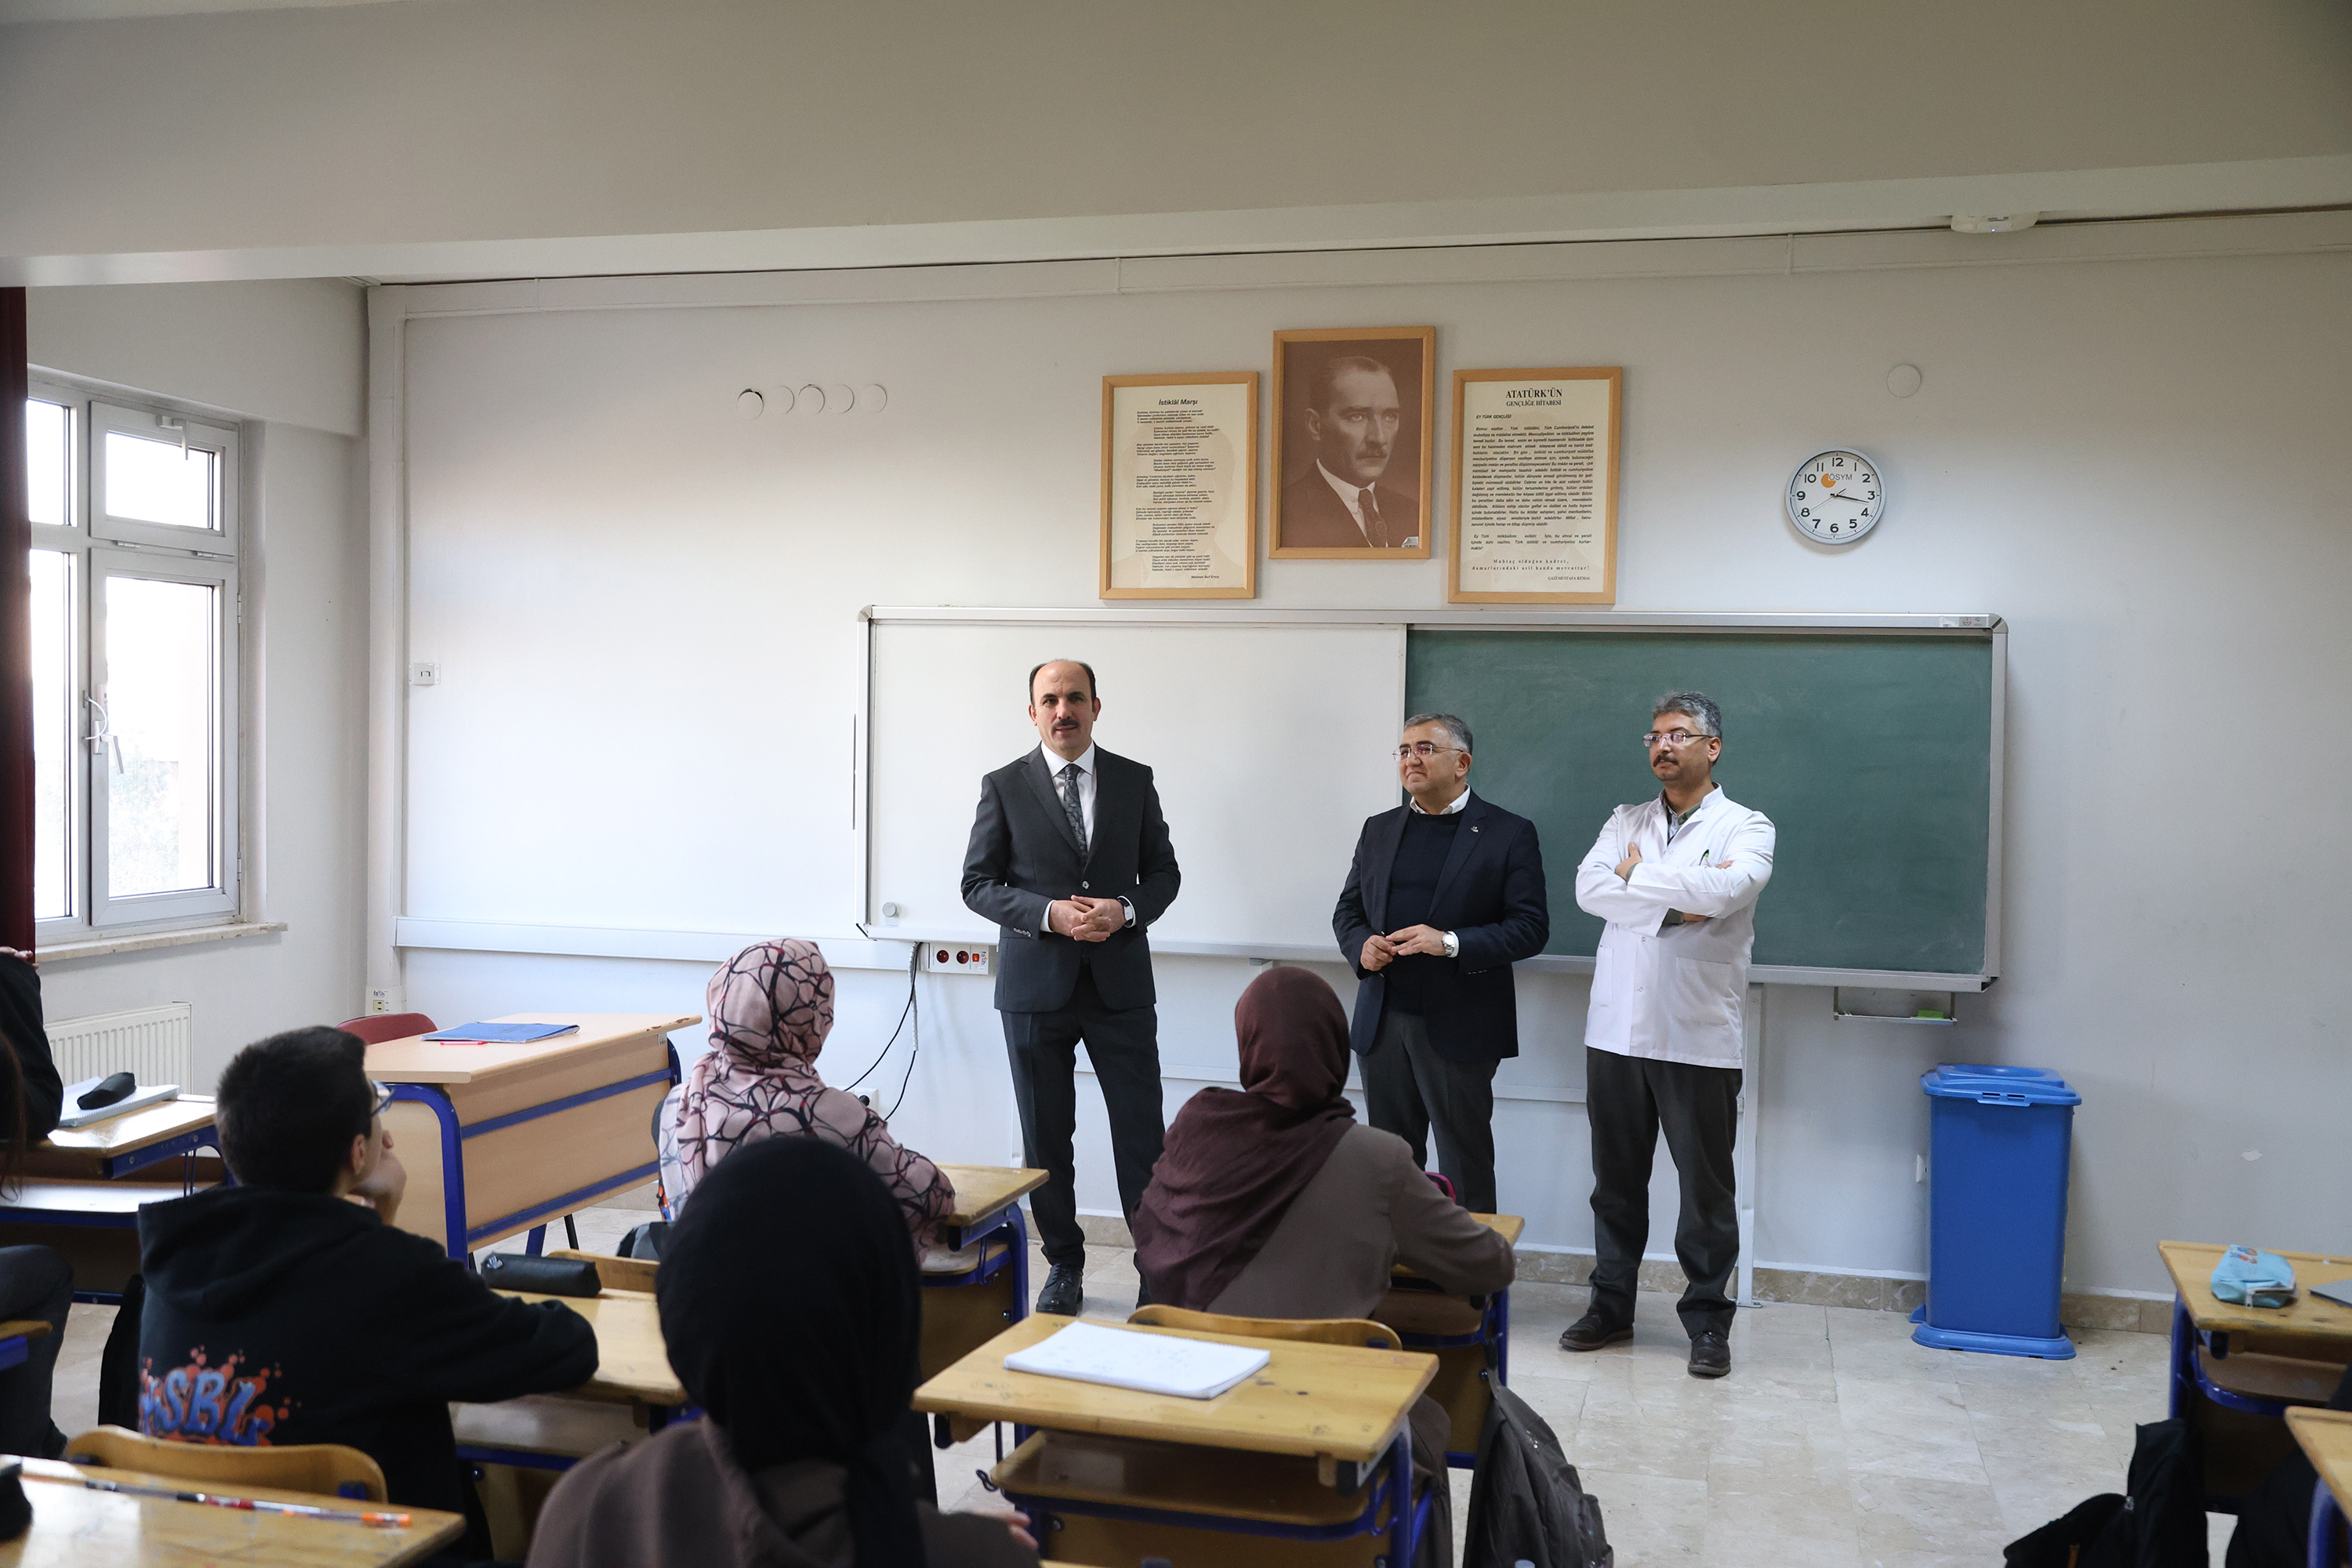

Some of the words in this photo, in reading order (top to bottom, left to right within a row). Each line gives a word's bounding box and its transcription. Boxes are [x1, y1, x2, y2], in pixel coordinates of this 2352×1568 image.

[1505, 387, 1563, 398] ATATÜRK'ÜN
[1832, 458, 1844, 466] 12
[1817, 463, 1824, 472] 11
[1854, 463, 1857, 471] 1
[1804, 474, 1817, 483] 10
[1862, 474, 1871, 483] 2
[1797, 492, 1806, 500] 9
[1867, 491, 1875, 499] 3
[1801, 508, 1810, 517] 8
[1861, 508, 1869, 517] 4
[1813, 519, 1820, 528] 7
[1849, 519, 1857, 528] 5
[1830, 524, 1838, 533] 6
